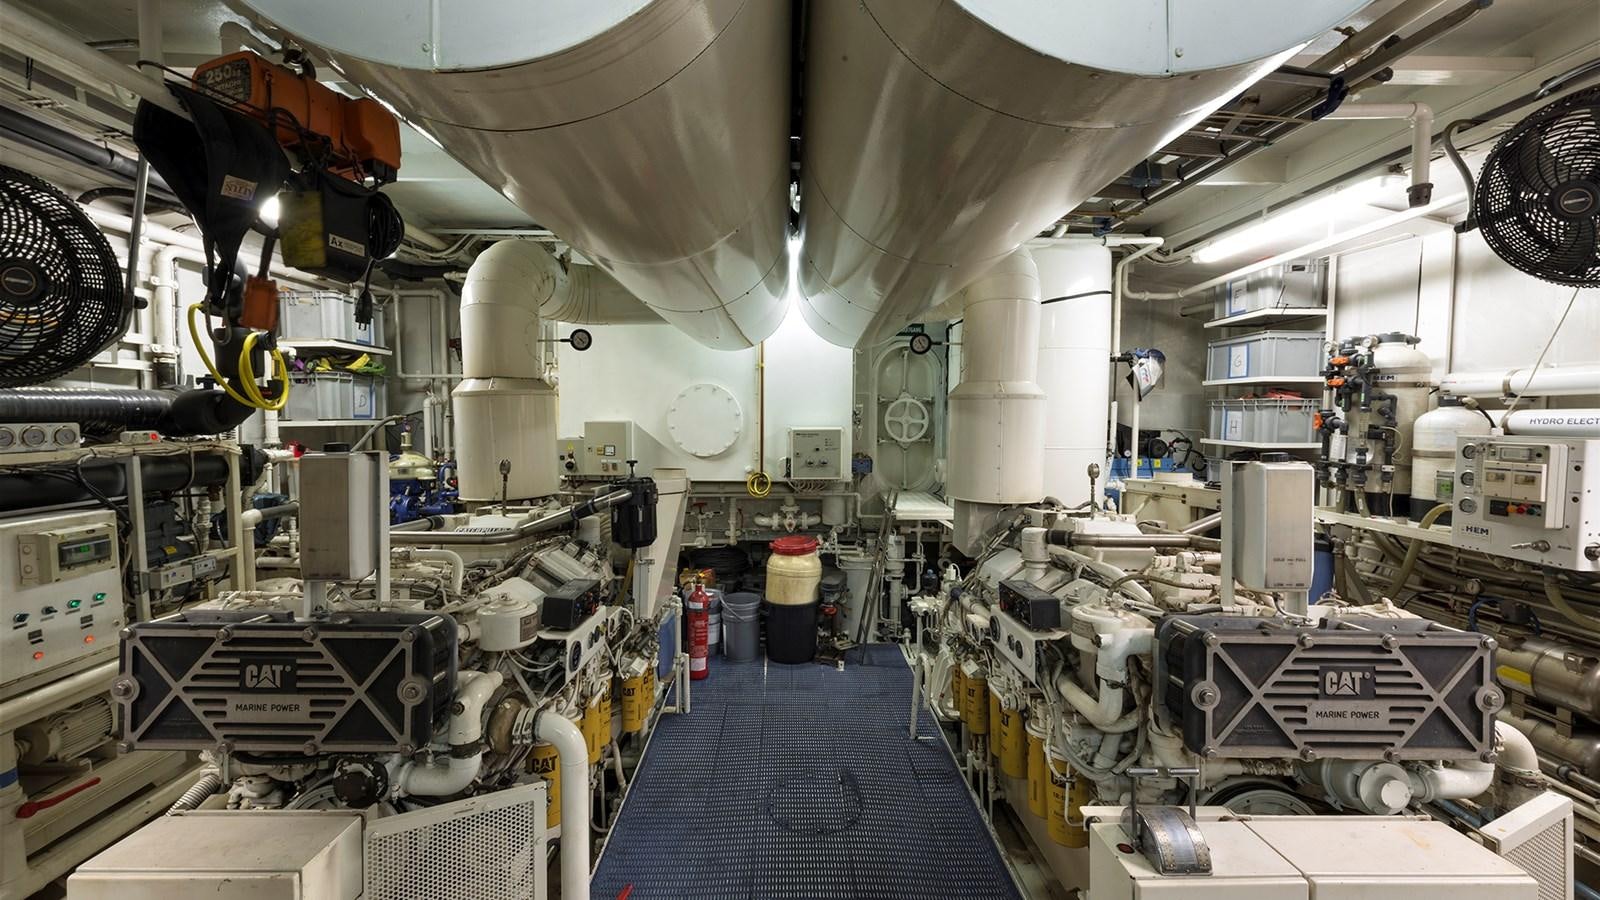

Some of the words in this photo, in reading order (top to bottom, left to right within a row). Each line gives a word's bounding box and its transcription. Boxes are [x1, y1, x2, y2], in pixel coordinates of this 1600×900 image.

[1530, 417, 1564, 425] HYDRO
[1466, 526, 1488, 535] HEM
[245, 664, 284, 688] CAT
[1325, 671, 1363, 696] CAT
[235, 703, 268, 712] MARINE
[270, 703, 300, 712] POWER
[1315, 711, 1348, 719] MARINE
[1350, 711, 1380, 719] POWER
[531, 755, 558, 774] CAT
